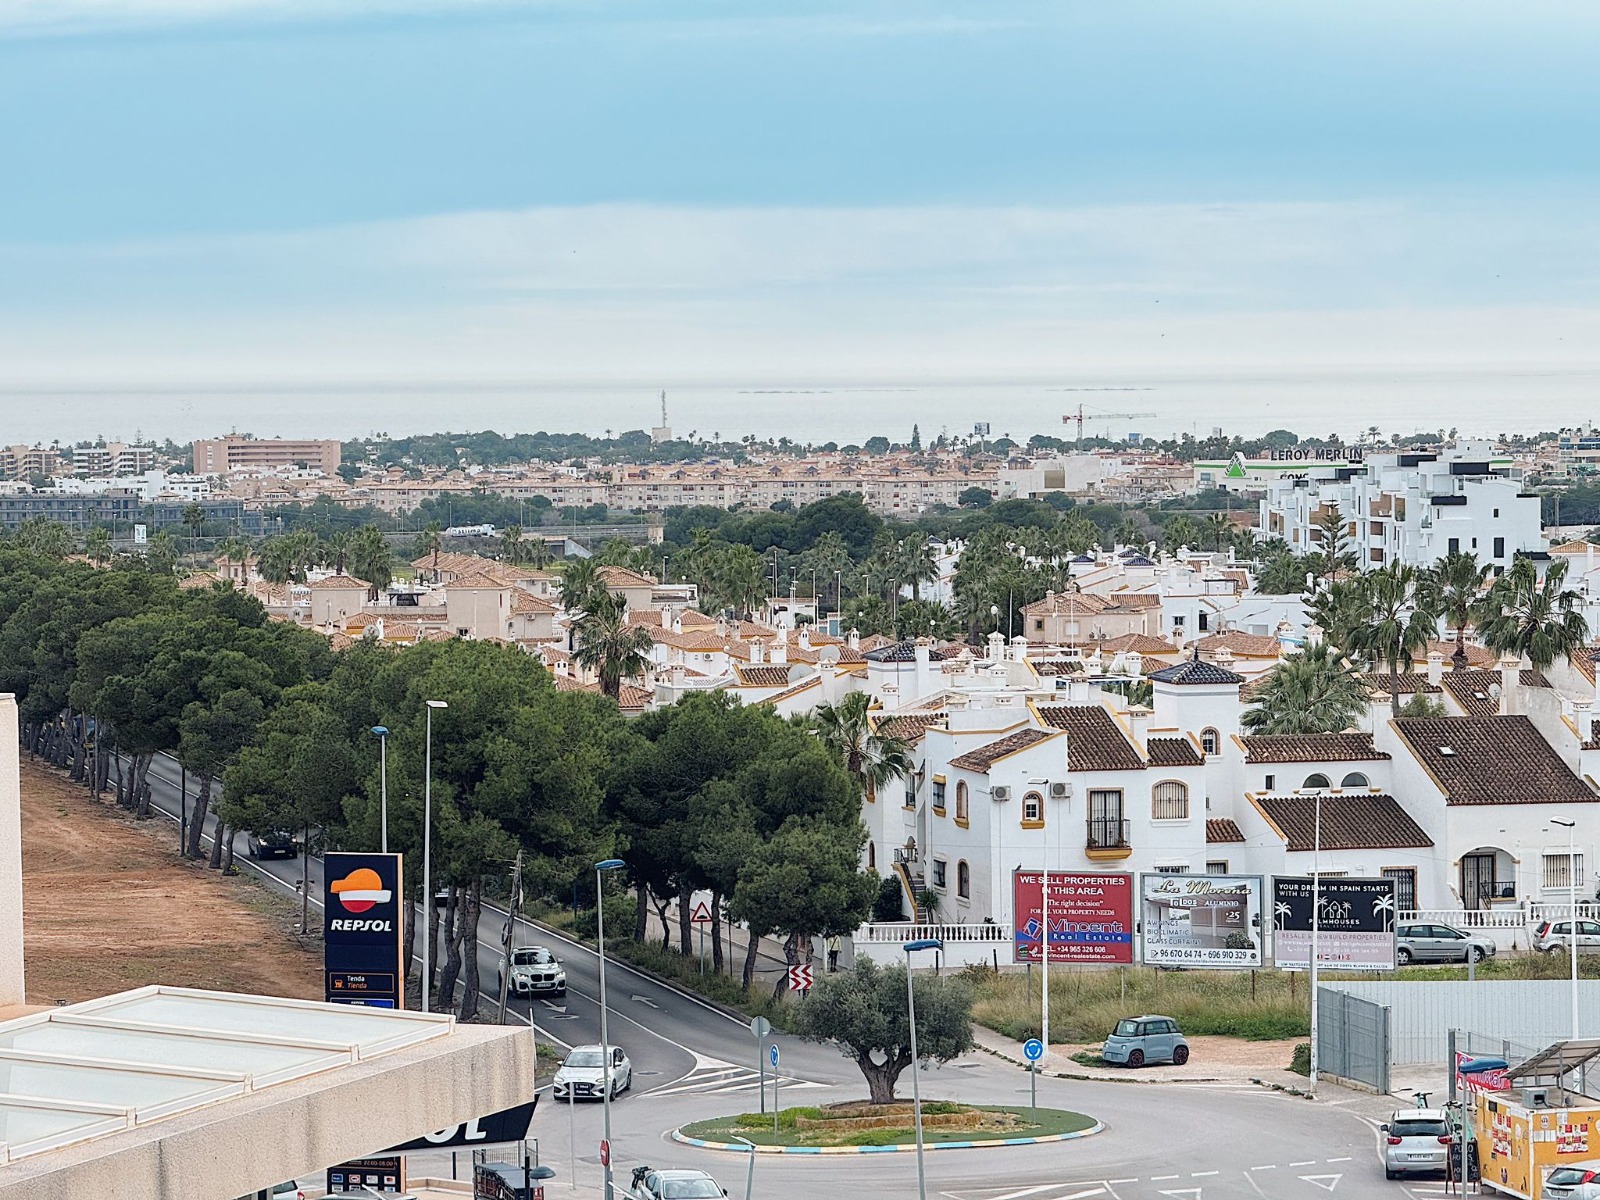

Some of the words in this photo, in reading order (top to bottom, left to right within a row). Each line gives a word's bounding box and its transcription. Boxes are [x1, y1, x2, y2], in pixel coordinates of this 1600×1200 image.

[1271, 450, 1310, 460] LEROY
[1316, 449, 1362, 460] MERLIN
[1152, 880, 1180, 893] La
[1186, 880, 1252, 894] Morena
[330, 919, 392, 932] REPSOL
[1047, 918, 1123, 933] Vincent
